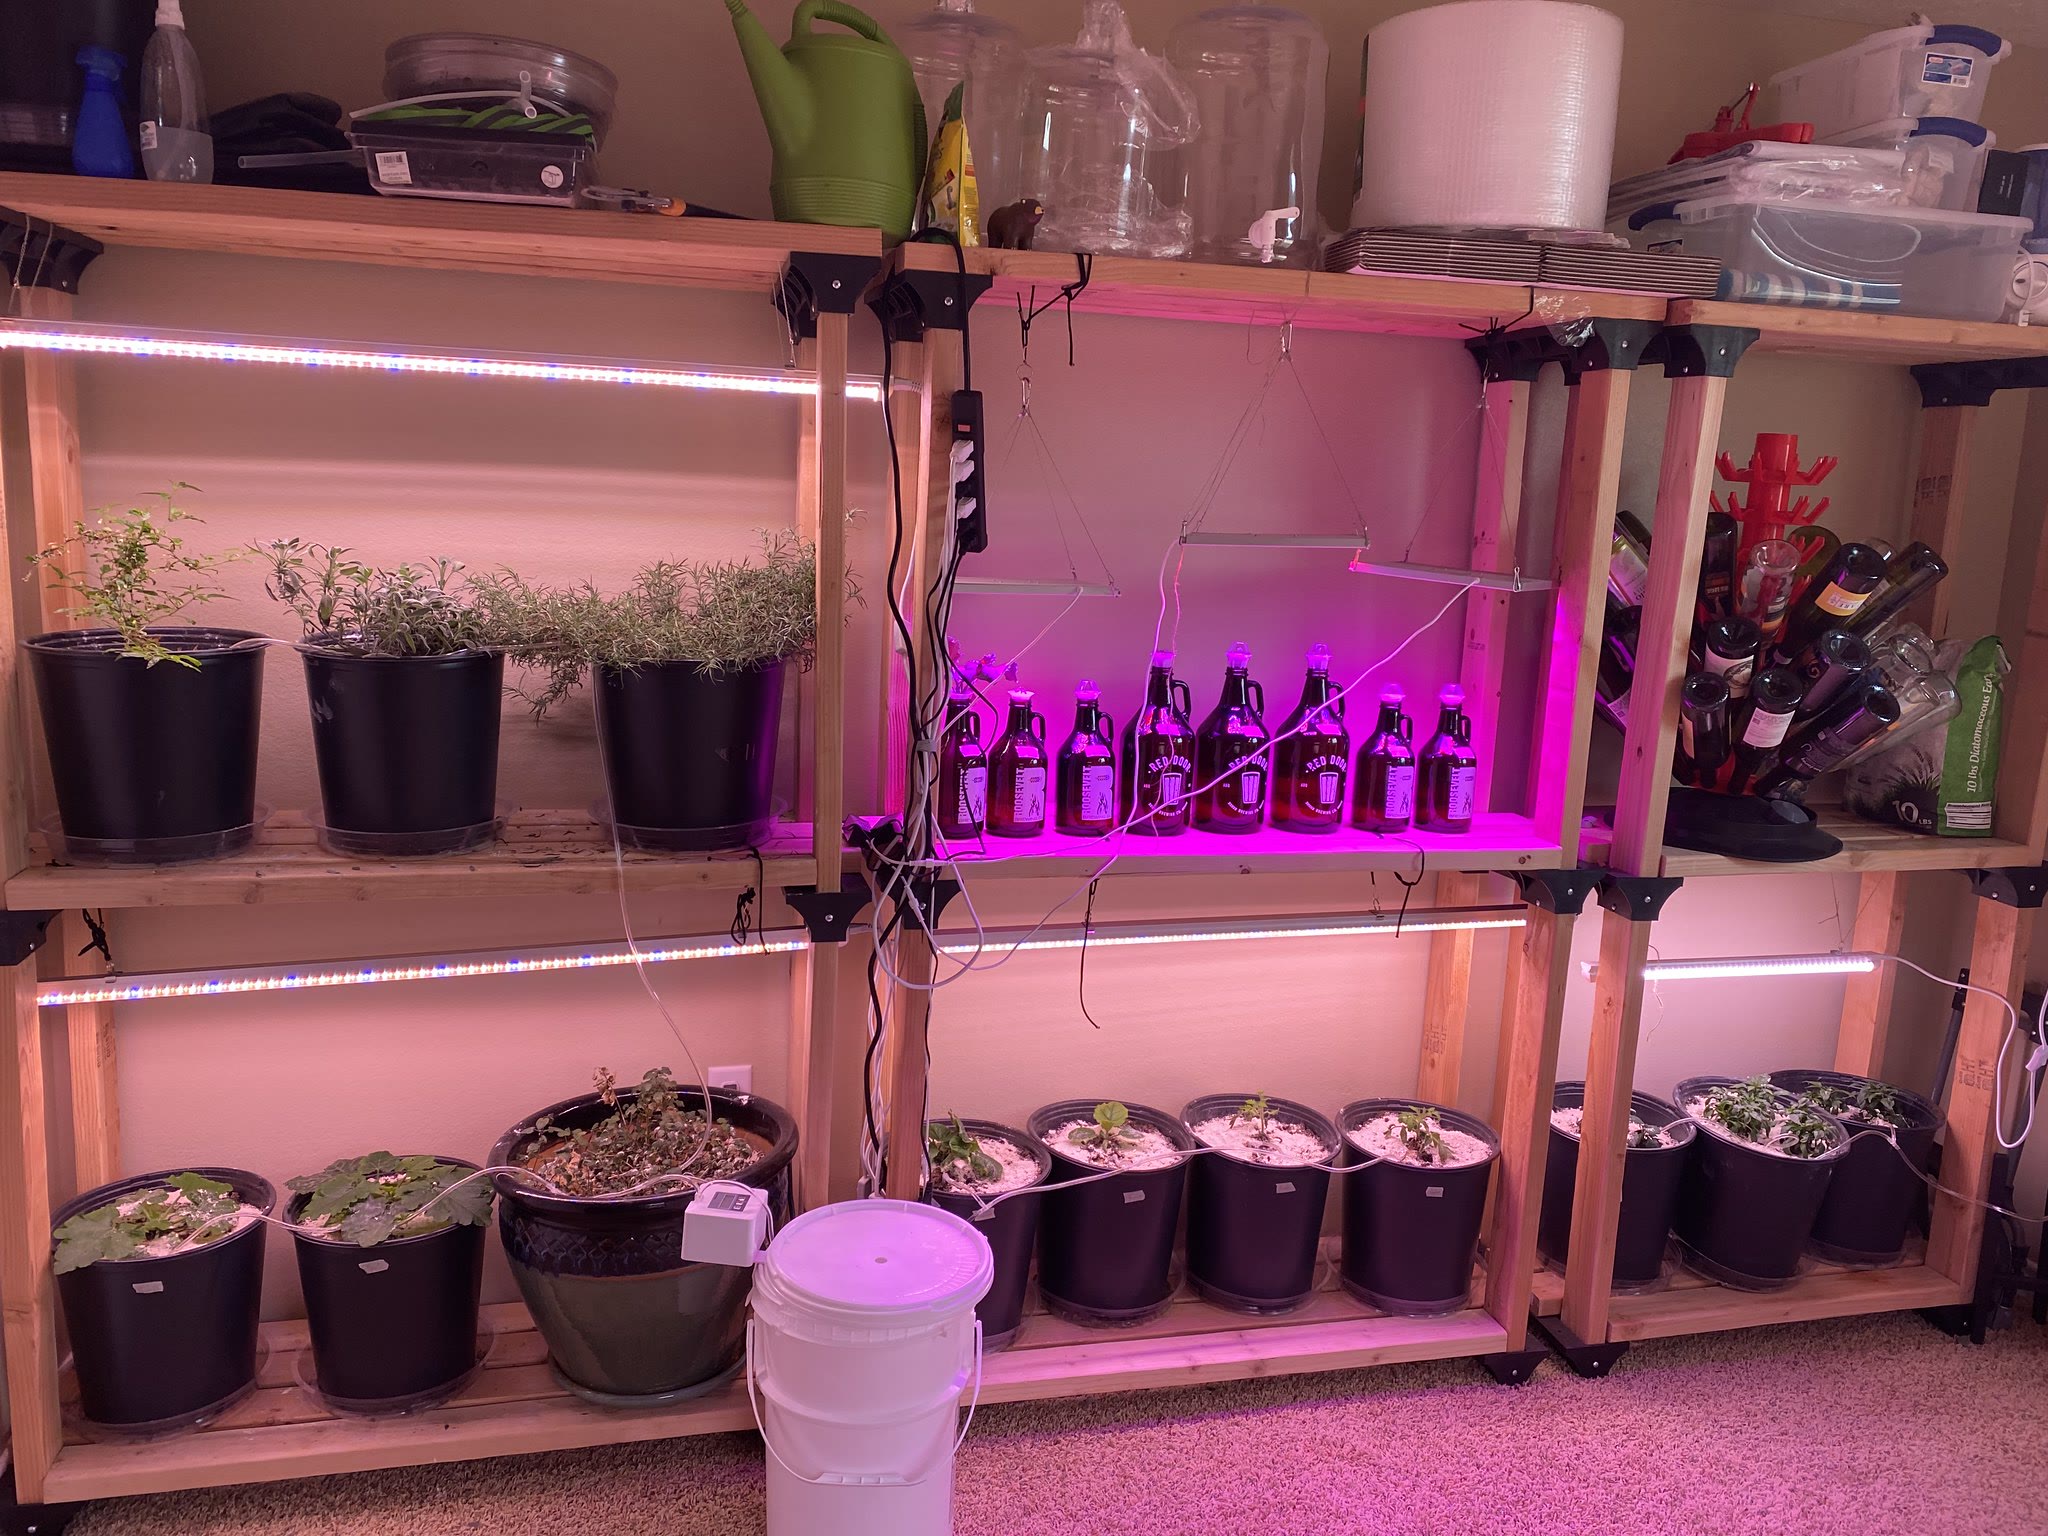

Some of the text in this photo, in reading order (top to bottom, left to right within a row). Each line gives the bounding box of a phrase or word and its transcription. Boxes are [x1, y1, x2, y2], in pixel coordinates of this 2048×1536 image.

[1970, 695, 1991, 763] Diatomaceous
[1149, 755, 1191, 772] RED DOOR
[1307, 755, 1346, 772] RED DOOR
[1968, 765, 1979, 779] lbs
[1014, 767, 1024, 816] ROOSEVELT
[1082, 766, 1091, 814] ROOSEVELT
[1386, 766, 1397, 812] ROOSEVELT
[1448, 767, 1460, 813] ROOSEVELT
[1967, 780, 1976, 793] 10
[1892, 800, 1919, 823] 10
